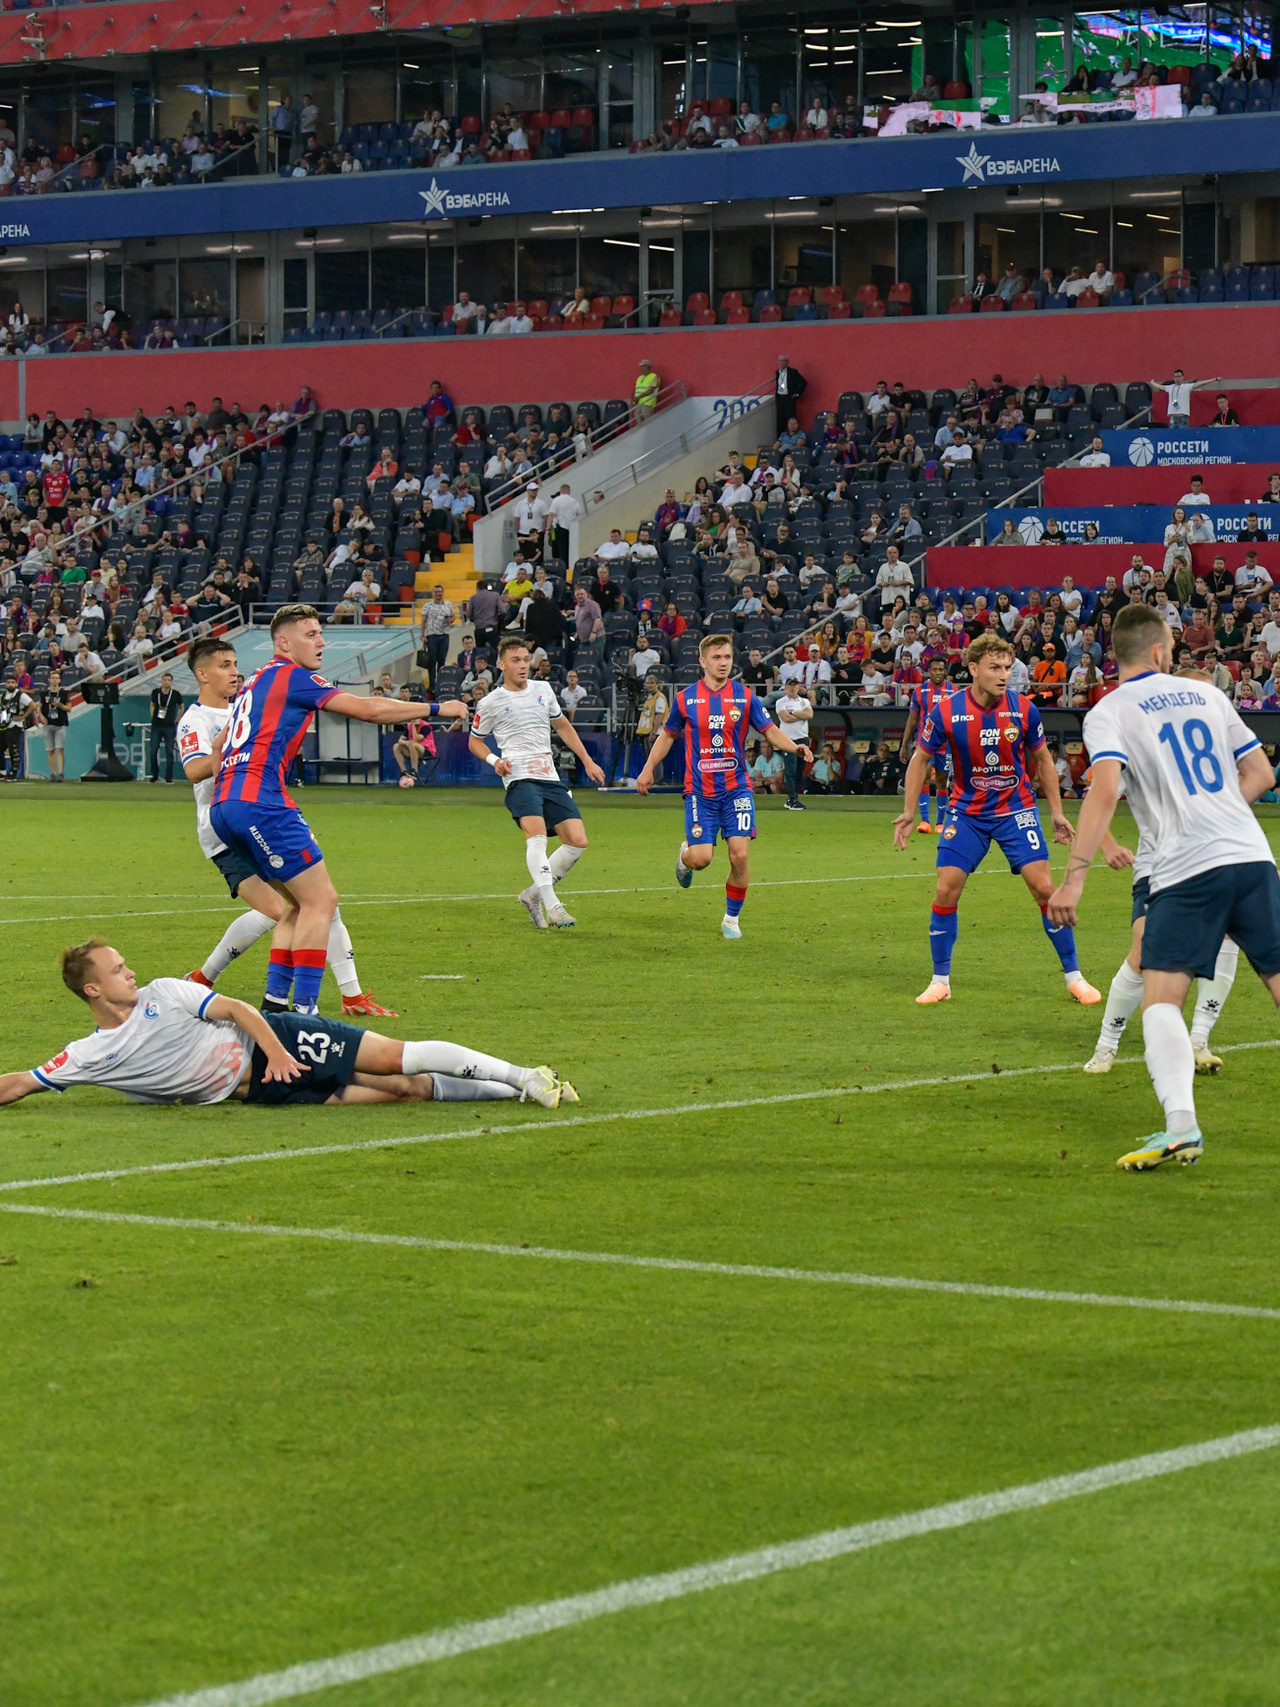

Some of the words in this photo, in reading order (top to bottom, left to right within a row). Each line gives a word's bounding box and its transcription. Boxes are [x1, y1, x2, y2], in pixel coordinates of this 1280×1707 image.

[986, 158, 1060, 176] ВЭБАРЕНА
[446, 192, 510, 209] ВЭБАРЕНА
[0, 224, 30, 238] РЕНА
[1157, 440, 1209, 453] РОССЕТИ
[1157, 455, 1203, 466] МОСКОВСКИЙ
[1203, 455, 1232, 465] РЕГИОН
[1217, 517, 1272, 530] РОССТИ
[1138, 691, 1207, 715] МЕНДЕЛЬ
[708, 721, 726, 729] BET
[980, 729, 1000, 738] FON
[980, 737, 1001, 746] BET
[1158, 718, 1224, 796] 18
[972, 764, 1015, 773] APOTHEKA
[736, 812, 751, 831] 10
[1026, 830, 1041, 850] 9
[297, 1030, 331, 1065] 23
